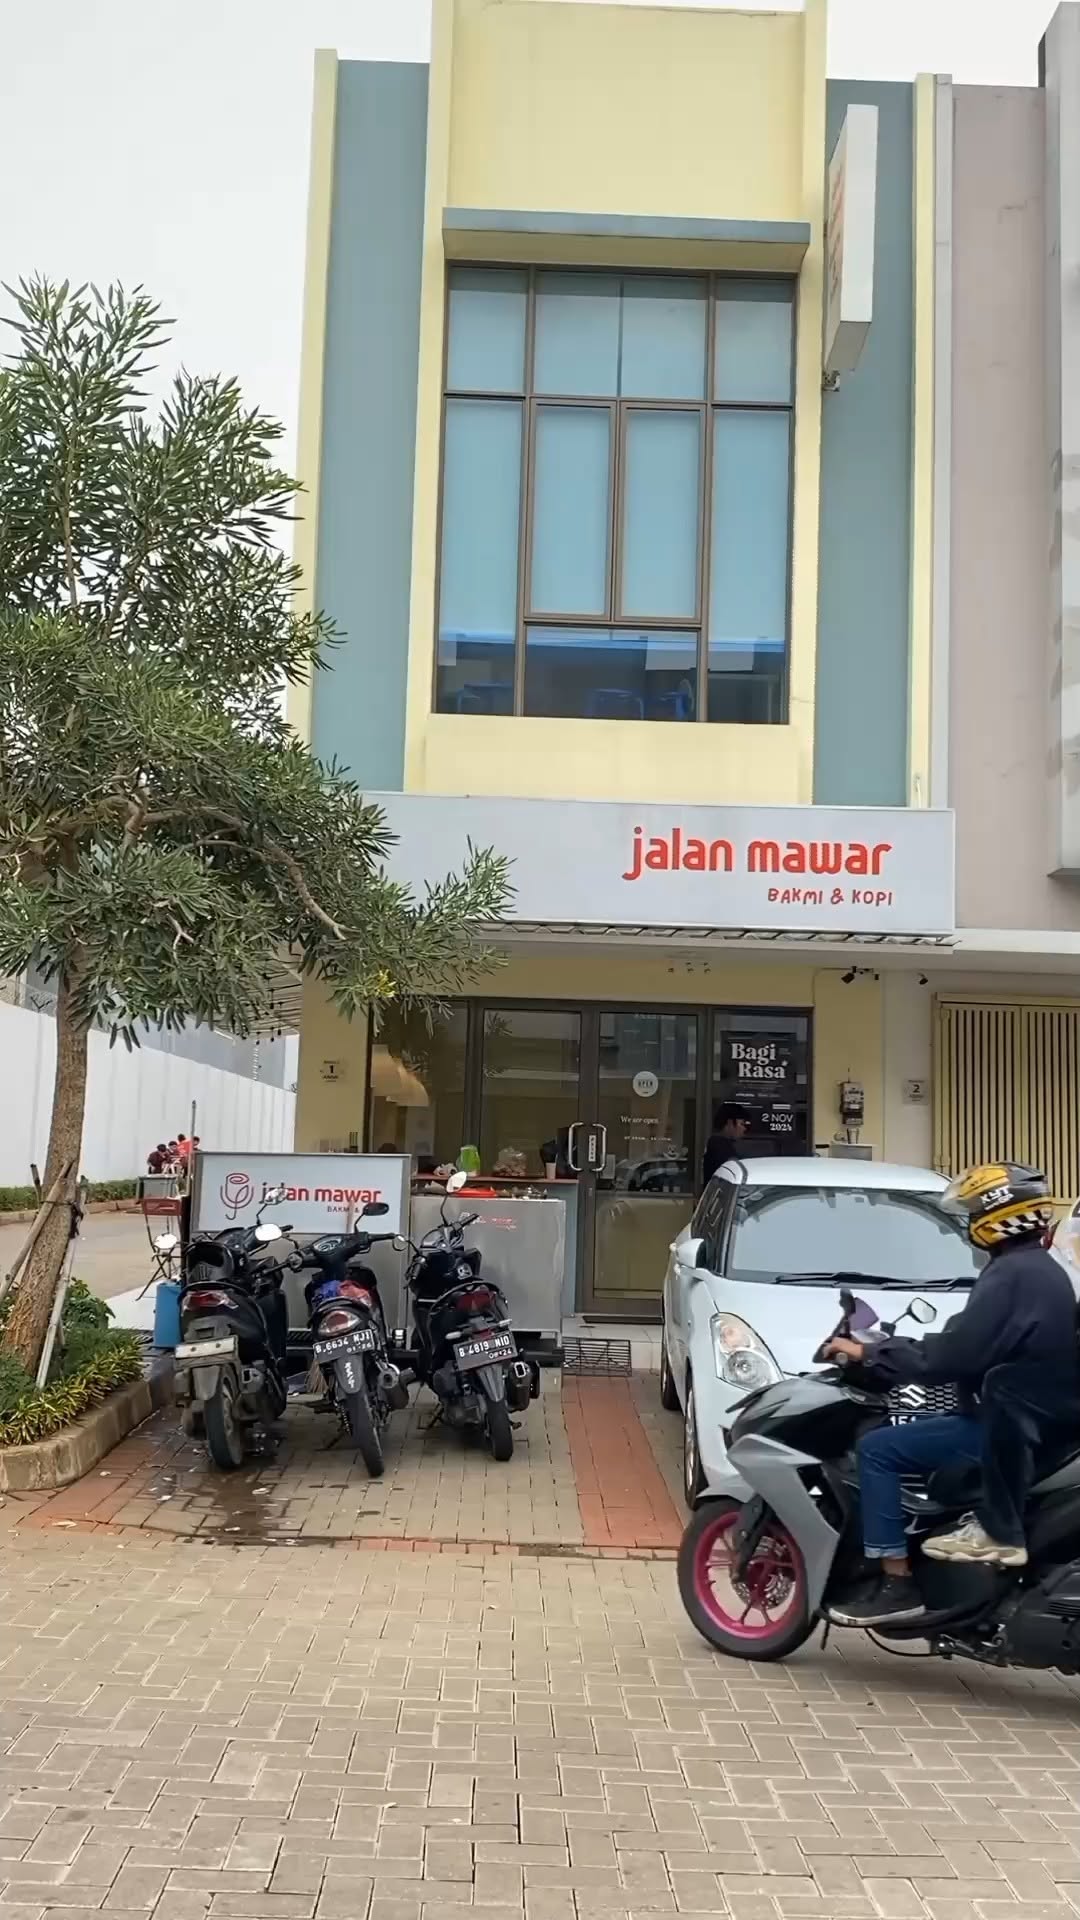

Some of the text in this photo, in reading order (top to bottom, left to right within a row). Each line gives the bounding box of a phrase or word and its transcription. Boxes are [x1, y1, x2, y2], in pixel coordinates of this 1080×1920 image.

[622, 826, 892, 881] jalan mawar
[767, 887, 893, 907] BAKMI & KOPI
[731, 1043, 776, 1066] Bagi
[738, 1061, 787, 1079] Rasa
[912, 1084, 920, 1094] 2
[761, 1113, 794, 1123] 2 NOV
[315, 1187, 382, 1204] mawar
[468, 1341, 489, 1354] 4819
